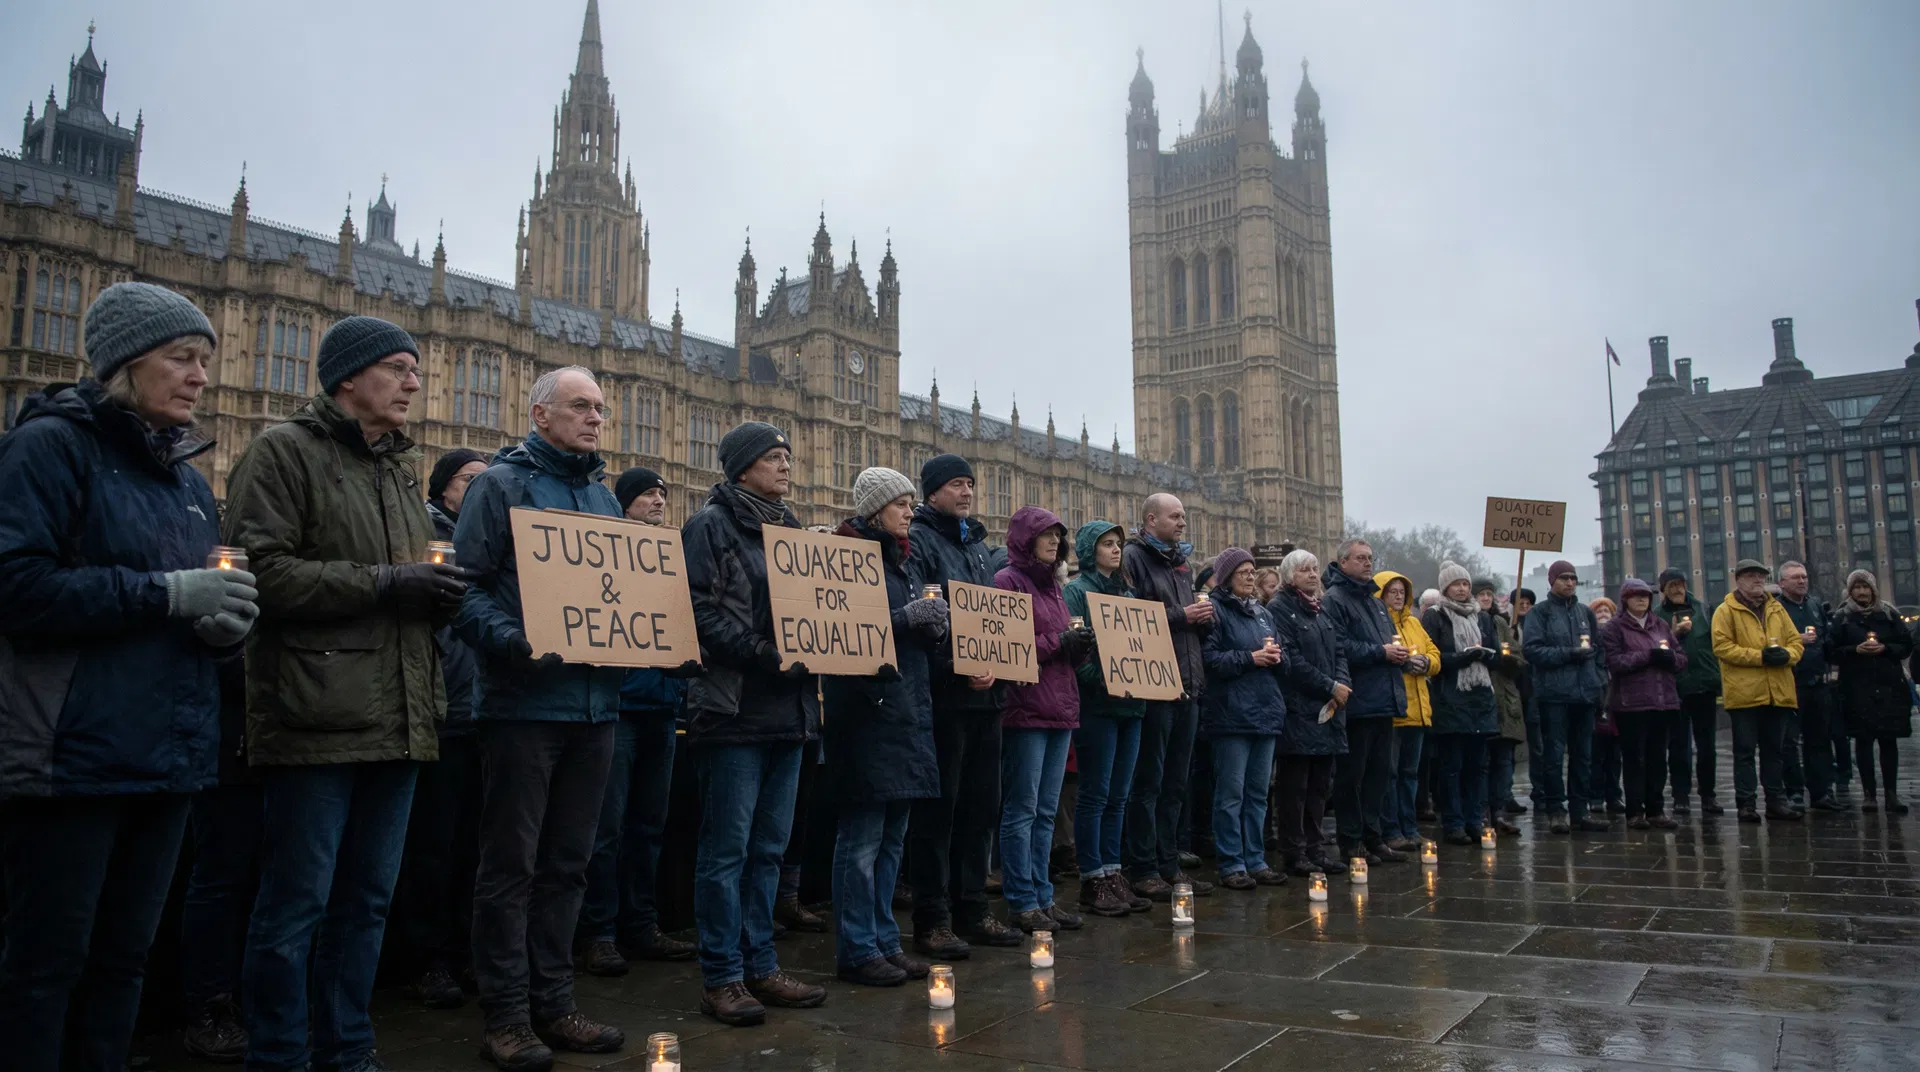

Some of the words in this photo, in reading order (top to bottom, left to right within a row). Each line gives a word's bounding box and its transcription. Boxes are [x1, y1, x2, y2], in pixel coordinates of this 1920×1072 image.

[1492, 528, 1557, 545] EQUALITY
[1511, 517, 1534, 528] FOR
[531, 524, 677, 577] JUSTICE
[773, 539, 880, 587] QUAKERS
[601, 572, 622, 605] &
[815, 587, 851, 612] FOR
[955, 587, 1028, 621] QUAKERS
[563, 605, 673, 652] PEACE
[982, 618, 1006, 636] FOR
[1100, 602, 1160, 636] FAITH
[781, 616, 889, 659] EQUALITY
[956, 635, 1032, 669] EQUALITY
[1128, 637, 1144, 653] IN
[1109, 656, 1176, 688] ACTION
